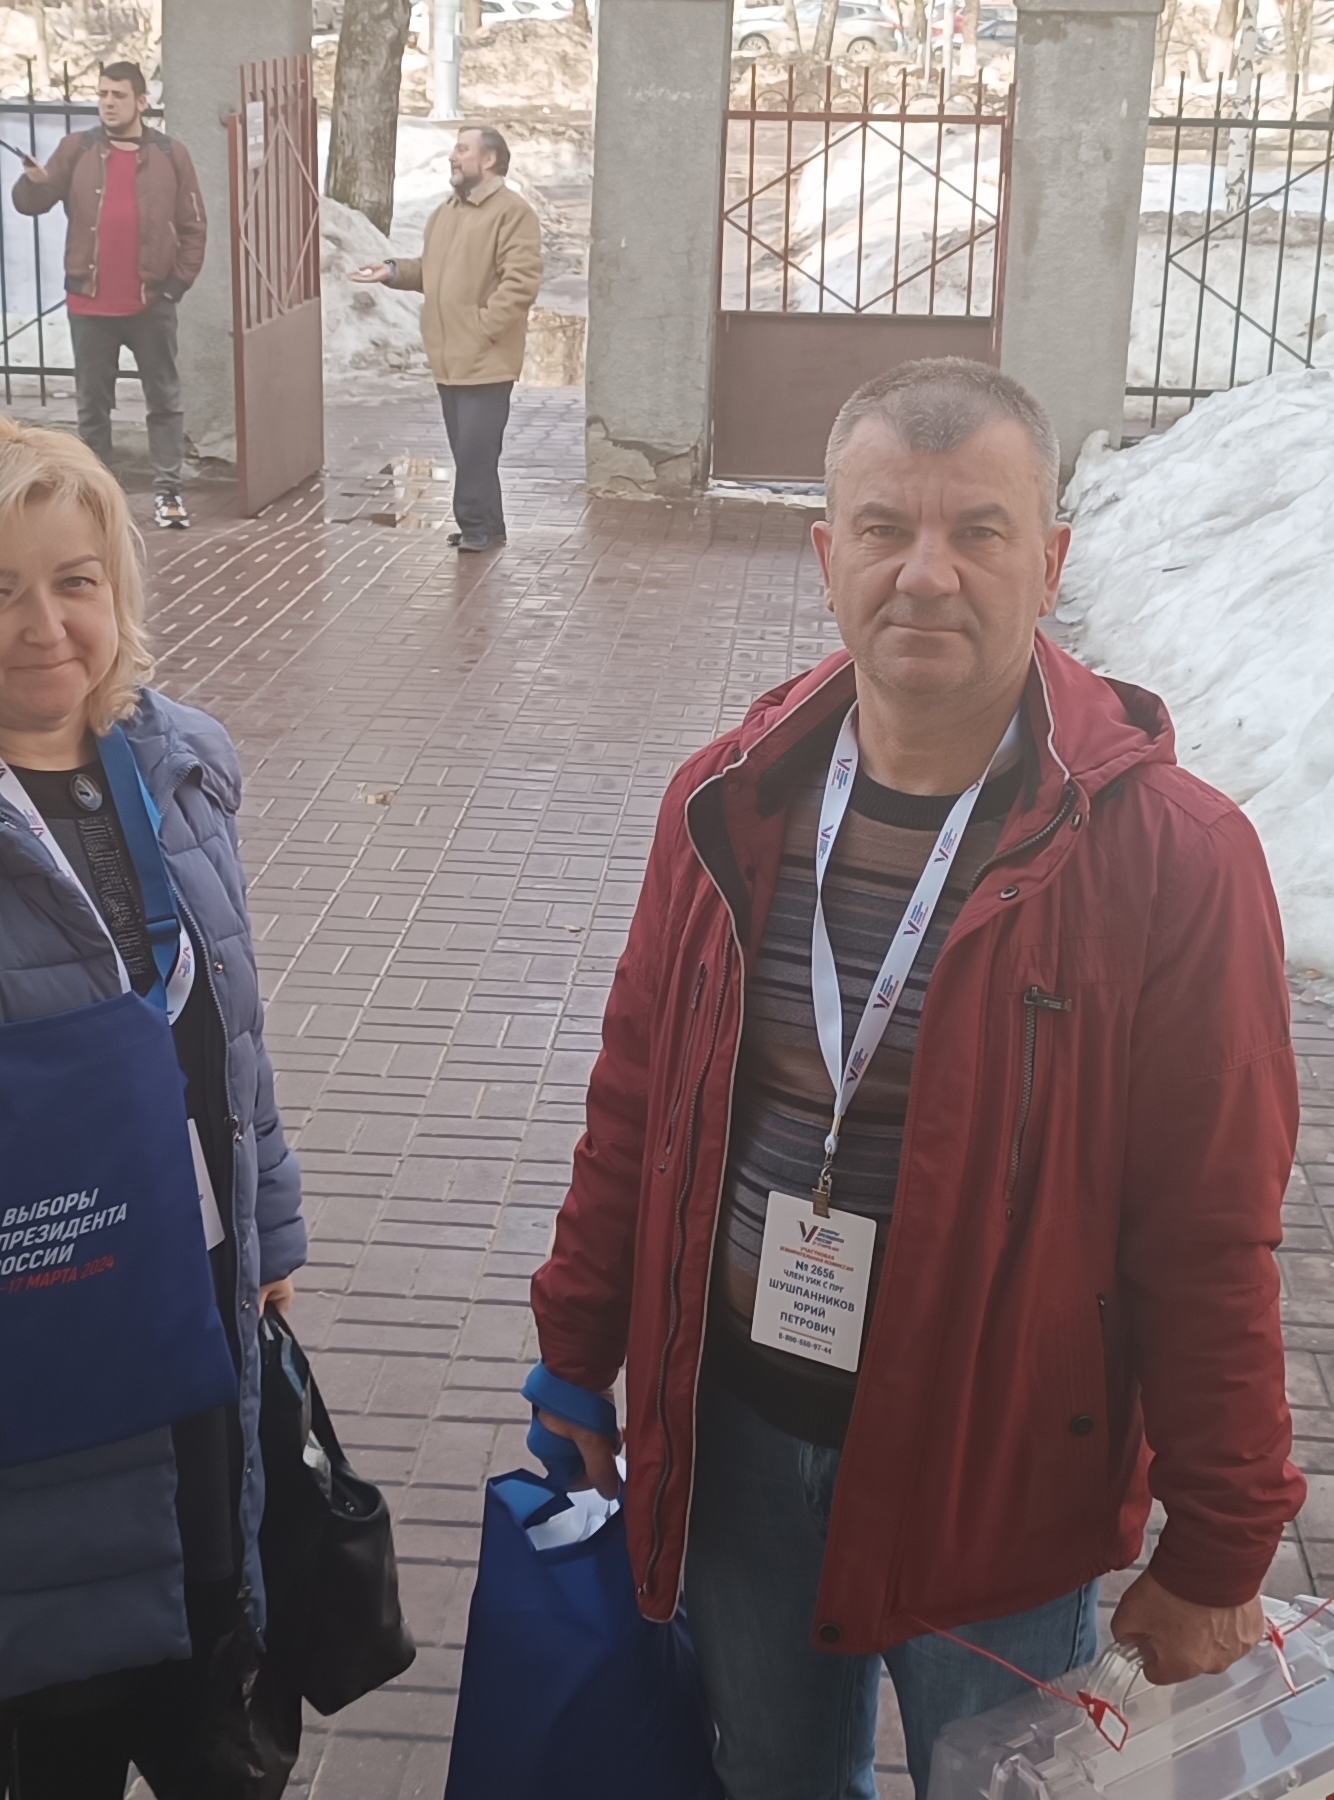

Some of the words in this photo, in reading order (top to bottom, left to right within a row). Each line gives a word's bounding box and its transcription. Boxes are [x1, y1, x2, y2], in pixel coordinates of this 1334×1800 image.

[1, 1187, 99, 1228] ВЫБОРЫ
[26, 1266, 78, 1290] МАРТА
[80, 1254, 115, 1279] 2024
[783, 1269, 805, 1281] ЧЛЕН
[805, 1275, 822, 1287] УИК
[810, 1264, 835, 1280] 2656
[769, 1278, 855, 1312] ШУШПАННИКОВ
[793, 1301, 826, 1318] ЮРИЙ
[779, 1311, 836, 1336] ПЕТРОВИЧ
